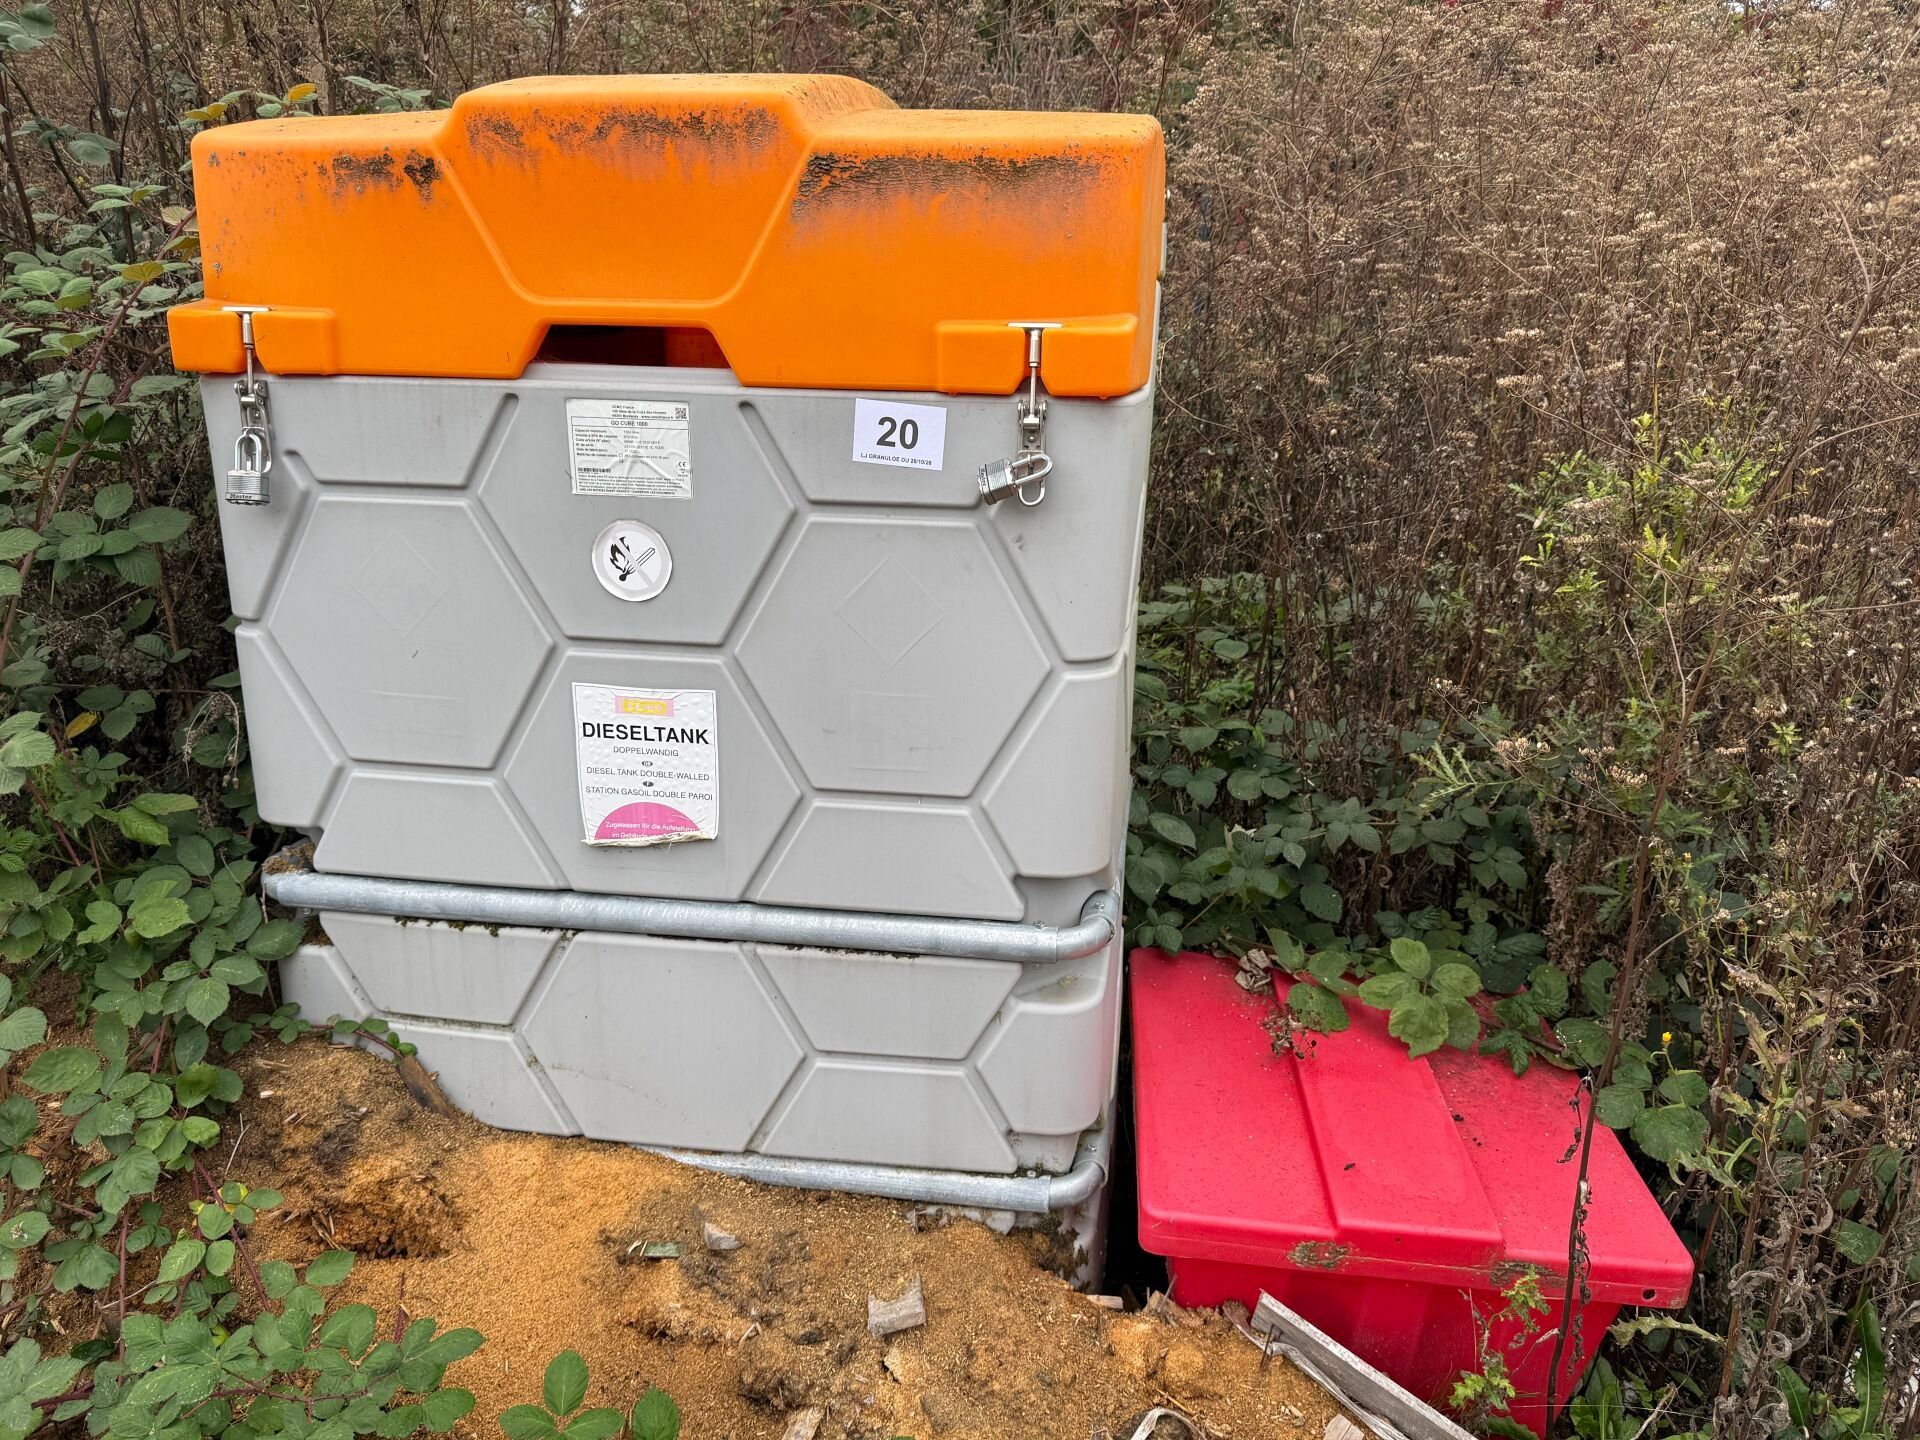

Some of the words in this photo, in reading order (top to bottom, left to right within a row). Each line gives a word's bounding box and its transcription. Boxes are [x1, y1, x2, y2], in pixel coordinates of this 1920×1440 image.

[876, 416, 918, 449] 20
[582, 722, 709, 744] DIESELTANK
[613, 746, 678, 757] DOPPELWANDIG
[586, 767, 615, 775] DIESEL
[640, 770, 709, 781] DOUBLE-WALLED
[586, 786, 619, 795] STATION
[621, 788, 651, 797] GASOIL
[653, 790, 686, 799] DOUBLE
[689, 792, 712, 800] PAROI
